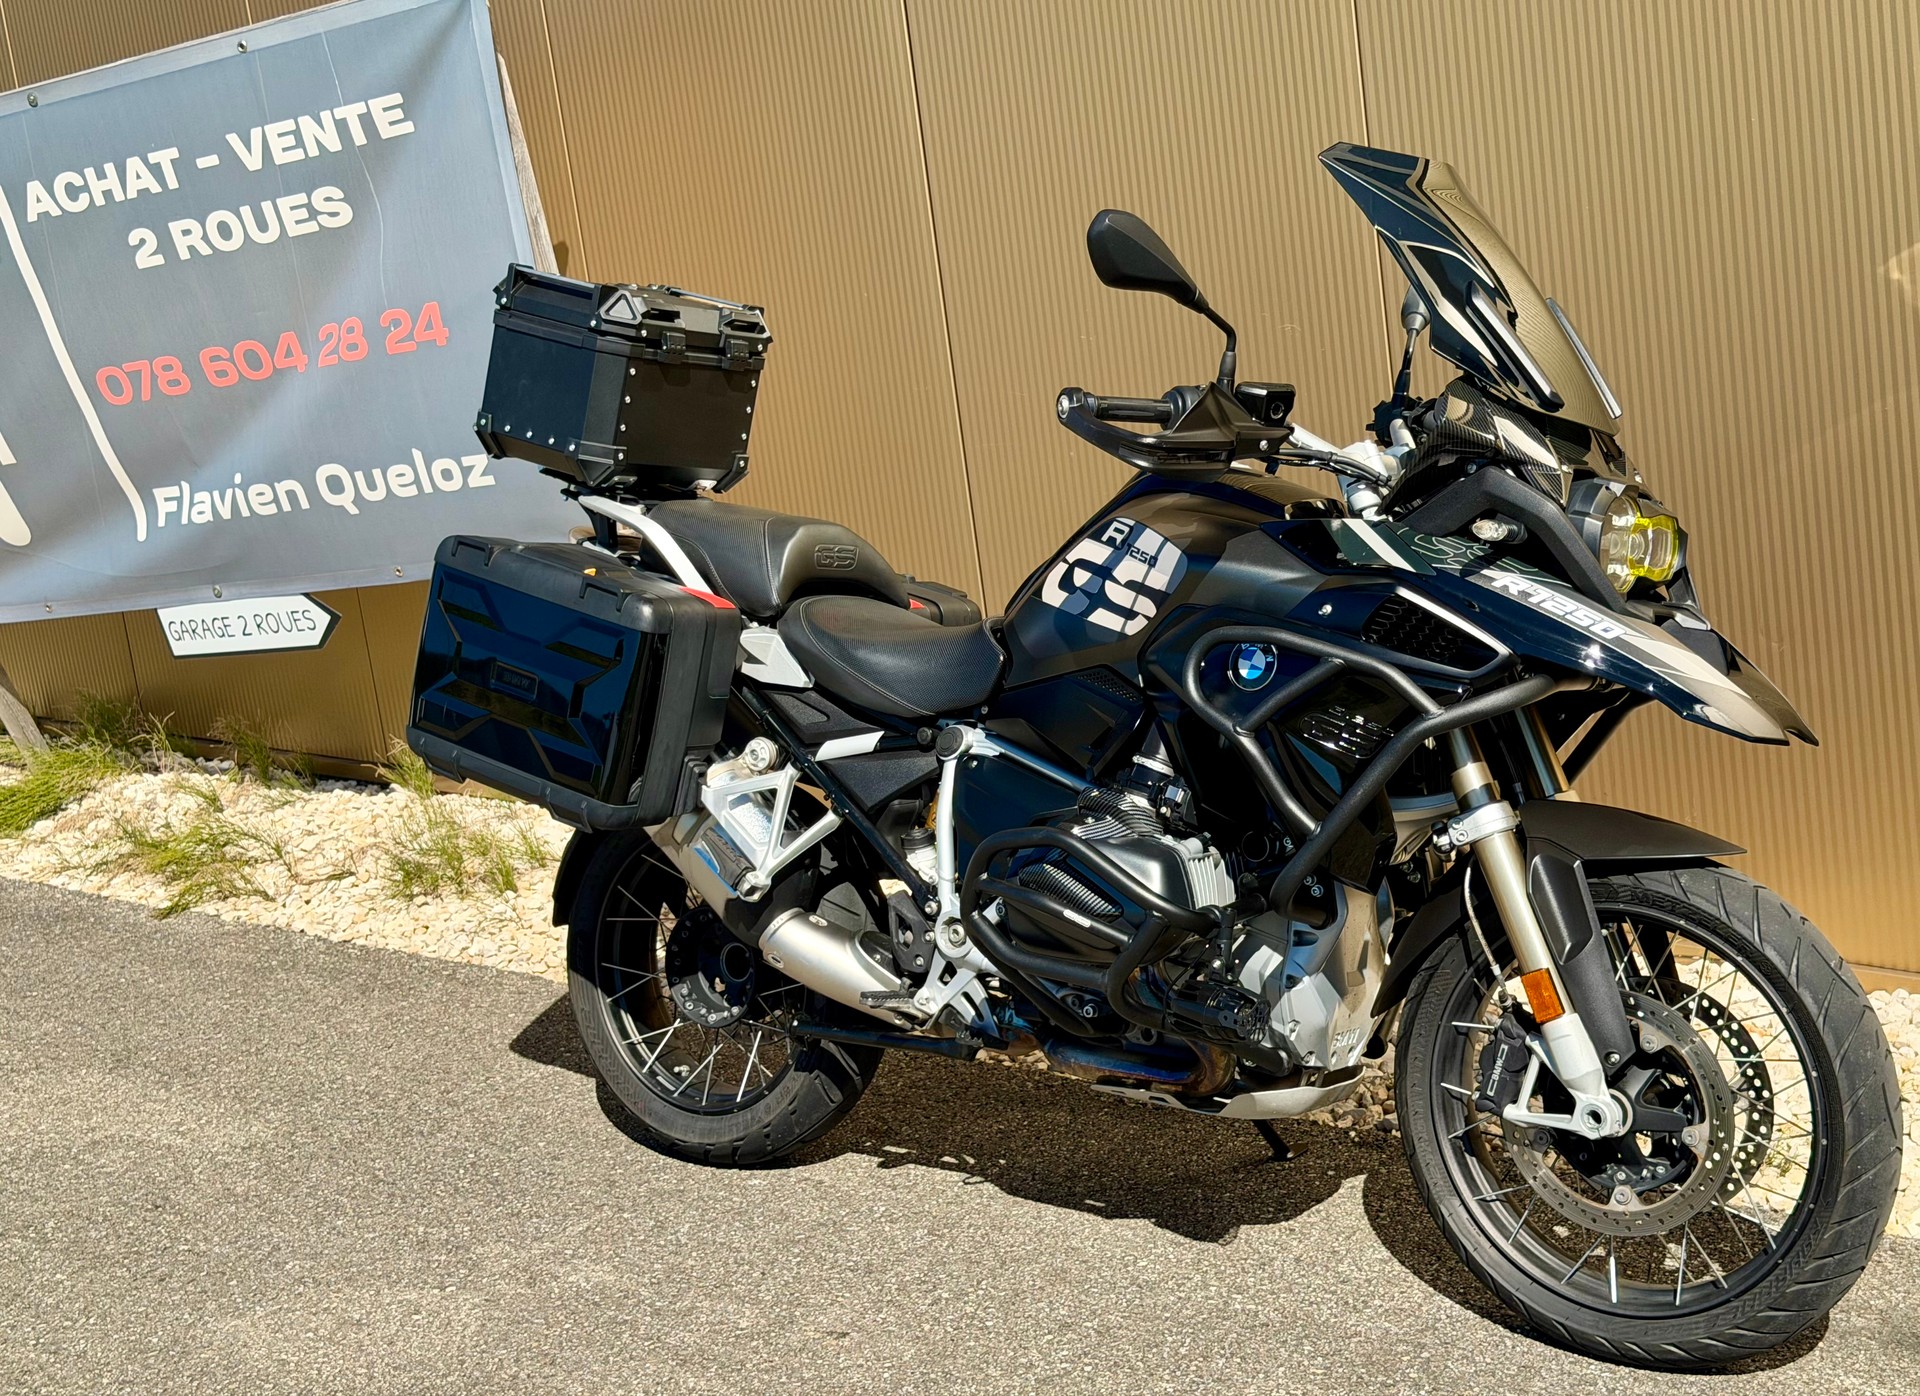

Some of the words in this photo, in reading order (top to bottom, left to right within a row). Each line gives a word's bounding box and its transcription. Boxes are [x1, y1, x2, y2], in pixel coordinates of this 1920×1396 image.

[27, 147, 180, 222] ACHAT
[226, 93, 415, 172] VENTE
[128, 228, 165, 270] 2
[169, 186, 354, 261] ROUES
[96, 355, 191, 406] 078
[200, 332, 309, 388] 604
[318, 317, 369, 367] 28
[380, 302, 449, 355] 24
[153, 474, 310, 528] Flavien
[316, 448, 496, 515] Queloz
[814, 544, 859, 571] GS
[1126, 543, 1158, 568] 1250
[168, 616, 236, 642] GARAGE
[237, 614, 253, 637] 2
[253, 609, 317, 636] ROUES
[1491, 576, 1626, 640] R1250
[1491, 1057, 1505, 1081] BMW
